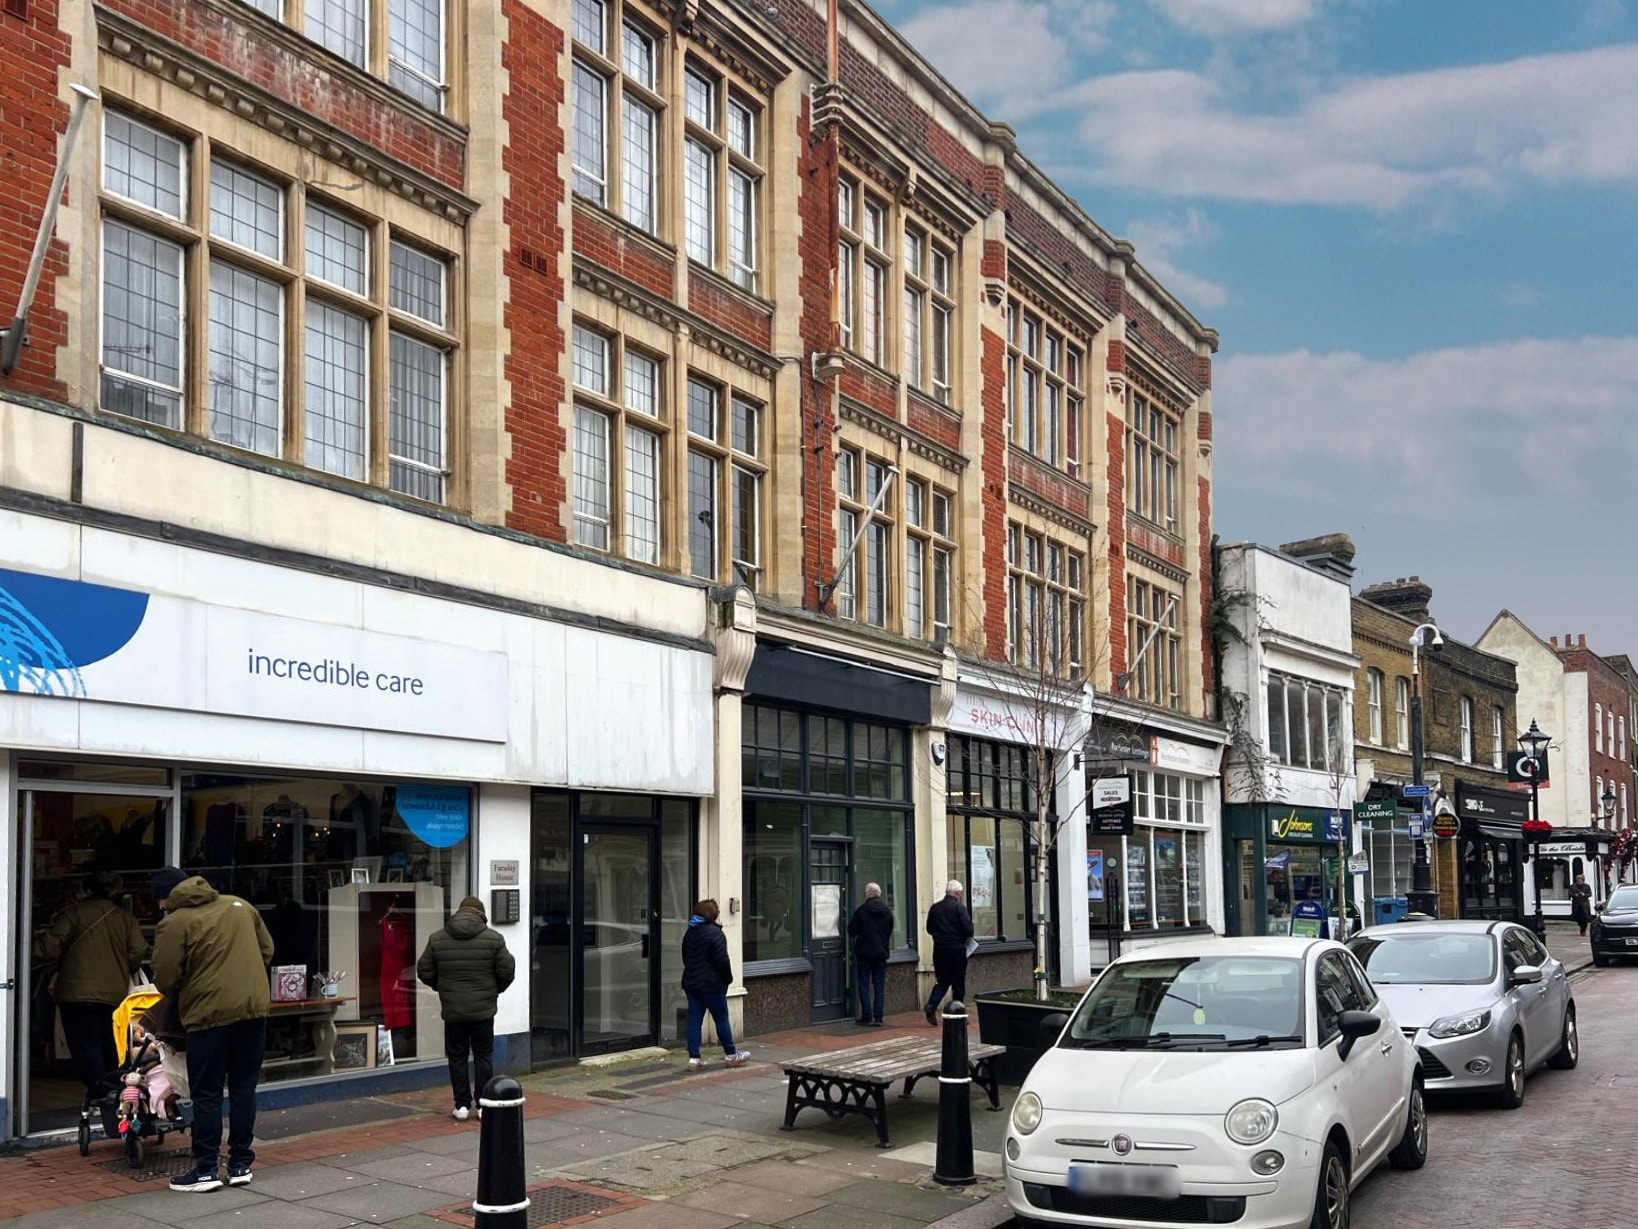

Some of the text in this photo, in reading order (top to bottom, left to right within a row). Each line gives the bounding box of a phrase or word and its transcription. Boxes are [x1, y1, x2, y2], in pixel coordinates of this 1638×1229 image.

[249, 648, 423, 695] incredible care
[971, 708, 1001, 726] SKIN
[1358, 810, 1394, 818] CLEANING
